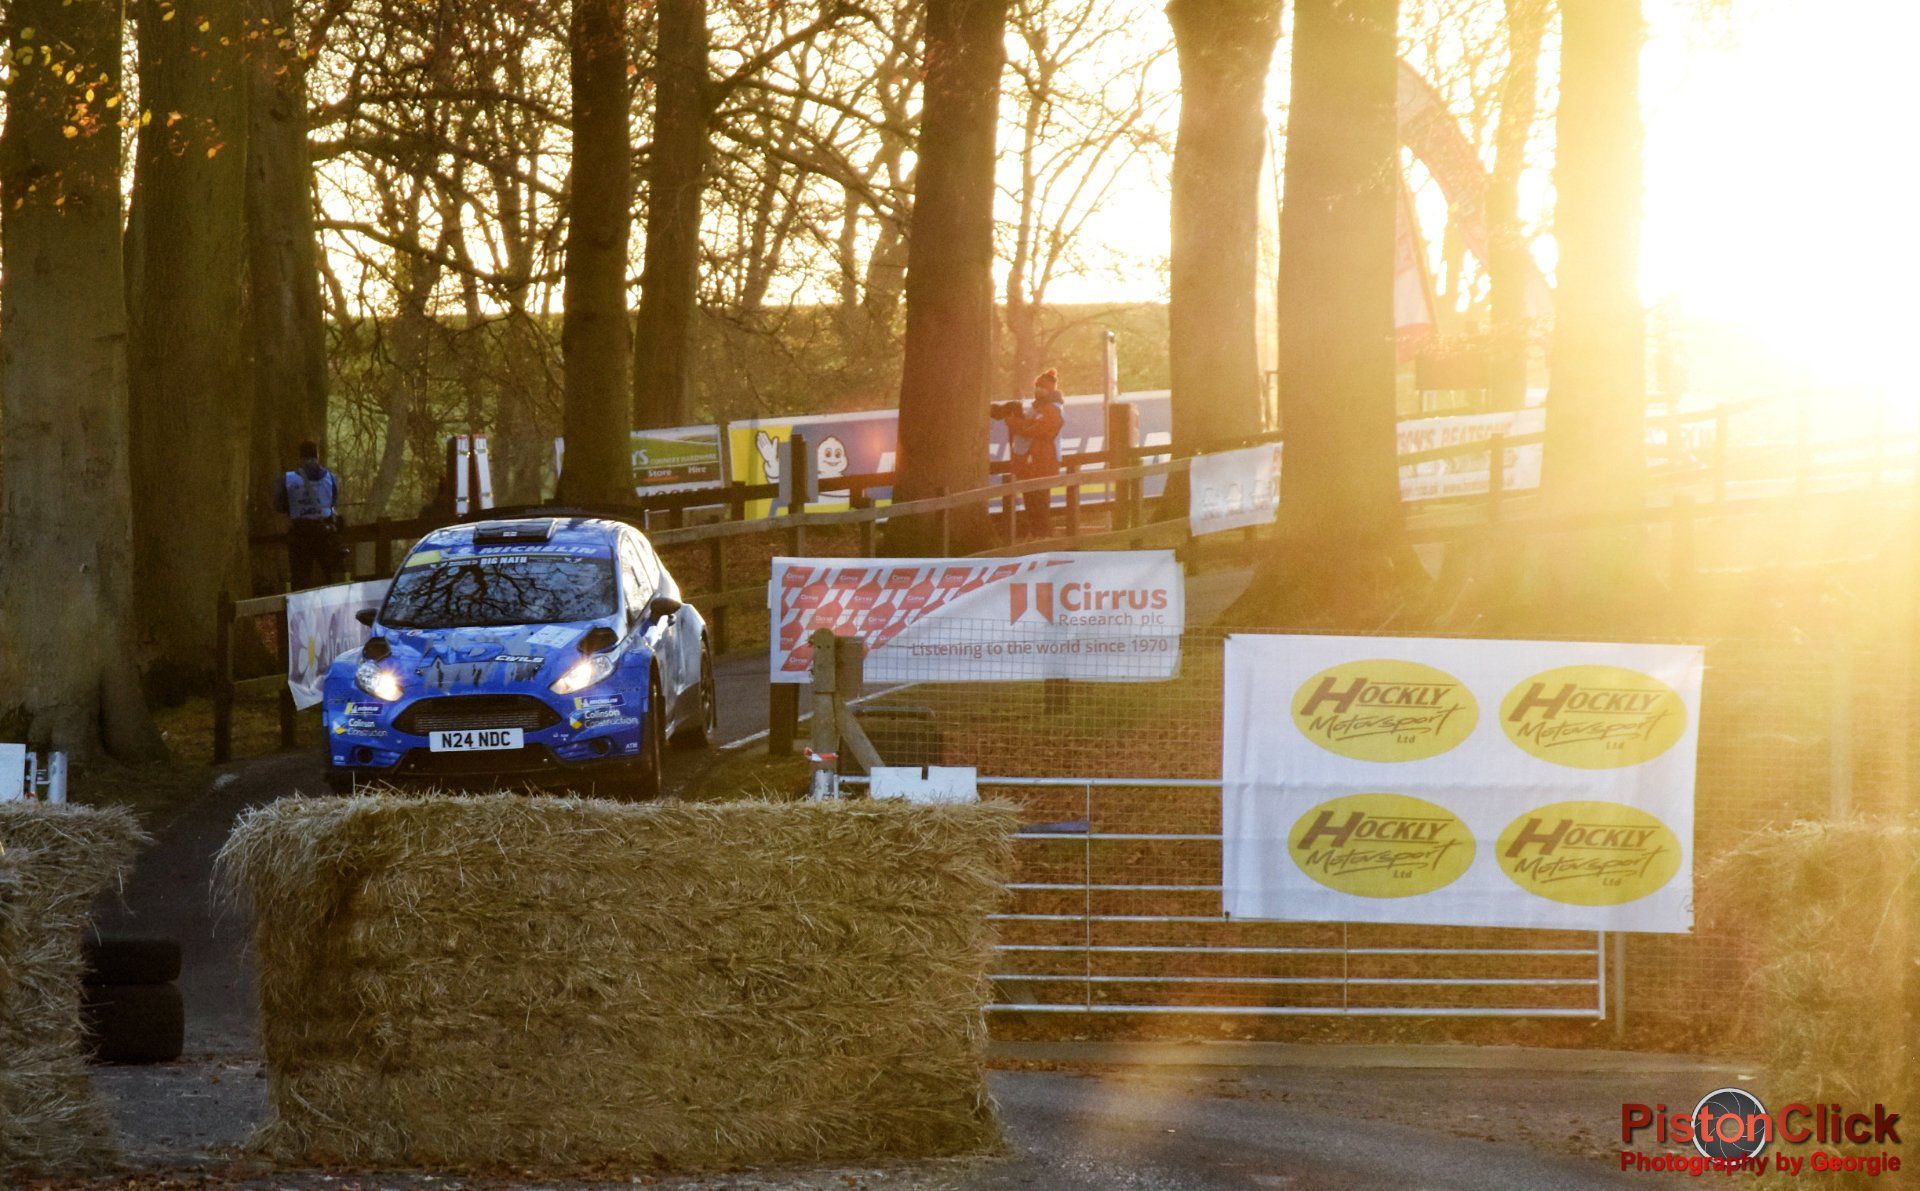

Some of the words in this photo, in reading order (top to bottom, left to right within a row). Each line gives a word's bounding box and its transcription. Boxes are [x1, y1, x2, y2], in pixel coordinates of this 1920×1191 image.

[648, 468, 672, 477] Store
[688, 465, 707, 474] Hire
[479, 545, 597, 555] MICHELIN
[480, 556, 498, 565] BIG
[1059, 582, 1168, 612] Cirrus
[1058, 612, 1134, 627] Research
[911, 640, 982, 659] Listening
[987, 641, 1004, 656] to
[1007, 640, 1032, 656] the
[1036, 639, 1081, 655] world
[1086, 638, 1126, 654] since
[1131, 638, 1168, 653] 1970
[1300, 677, 1451, 716] HOCKLY
[1508, 682, 1661, 722] HOCKLY
[584, 709, 621, 719] Collinson
[1309, 703, 1466, 740] Motorsport
[585, 717, 639, 729] Construction
[1517, 708, 1673, 745] Motorsport
[442, 732, 473, 748] N24
[479, 731, 511, 747] NDC
[1397, 735, 1416, 744] Ltd
[1606, 741, 1625, 750] Ltd
[1297, 810, 1448, 850] HOCKLY
[1505, 818, 1656, 858] HOCKLY
[1306, 838, 1463, 874] Motorsport
[1514, 845, 1670, 881] Motorsport
[1393, 870, 1412, 879] Ltd
[1602, 877, 1622, 887] Ltd
